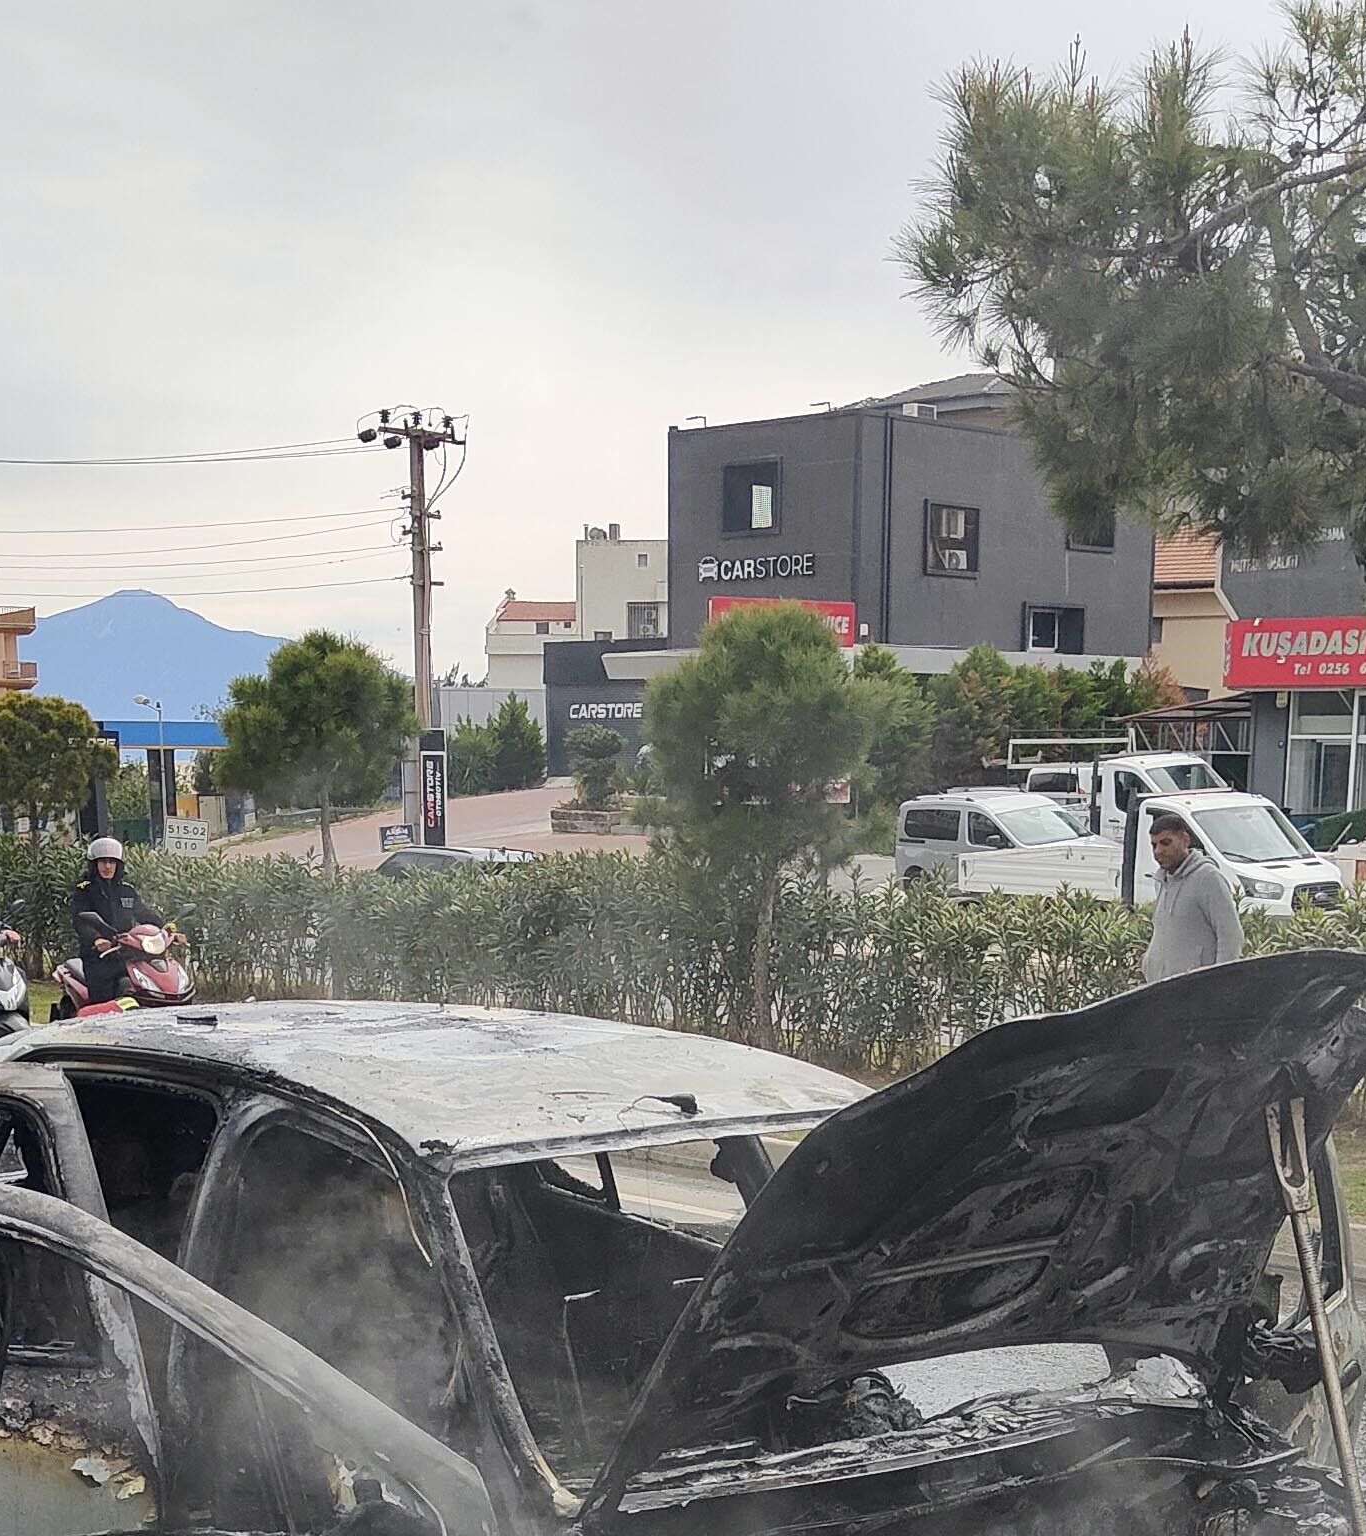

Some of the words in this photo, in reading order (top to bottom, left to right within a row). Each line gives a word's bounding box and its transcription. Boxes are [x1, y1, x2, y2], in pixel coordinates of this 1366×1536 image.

[719, 553, 815, 582] CARSTORE
[1293, 662, 1312, 676] Tel
[1318, 662, 1351, 675] 0256
[569, 702, 644, 719] CARSTORE
[426, 760, 435, 828] CARSTORE
[175, 840, 197, 850] 010
